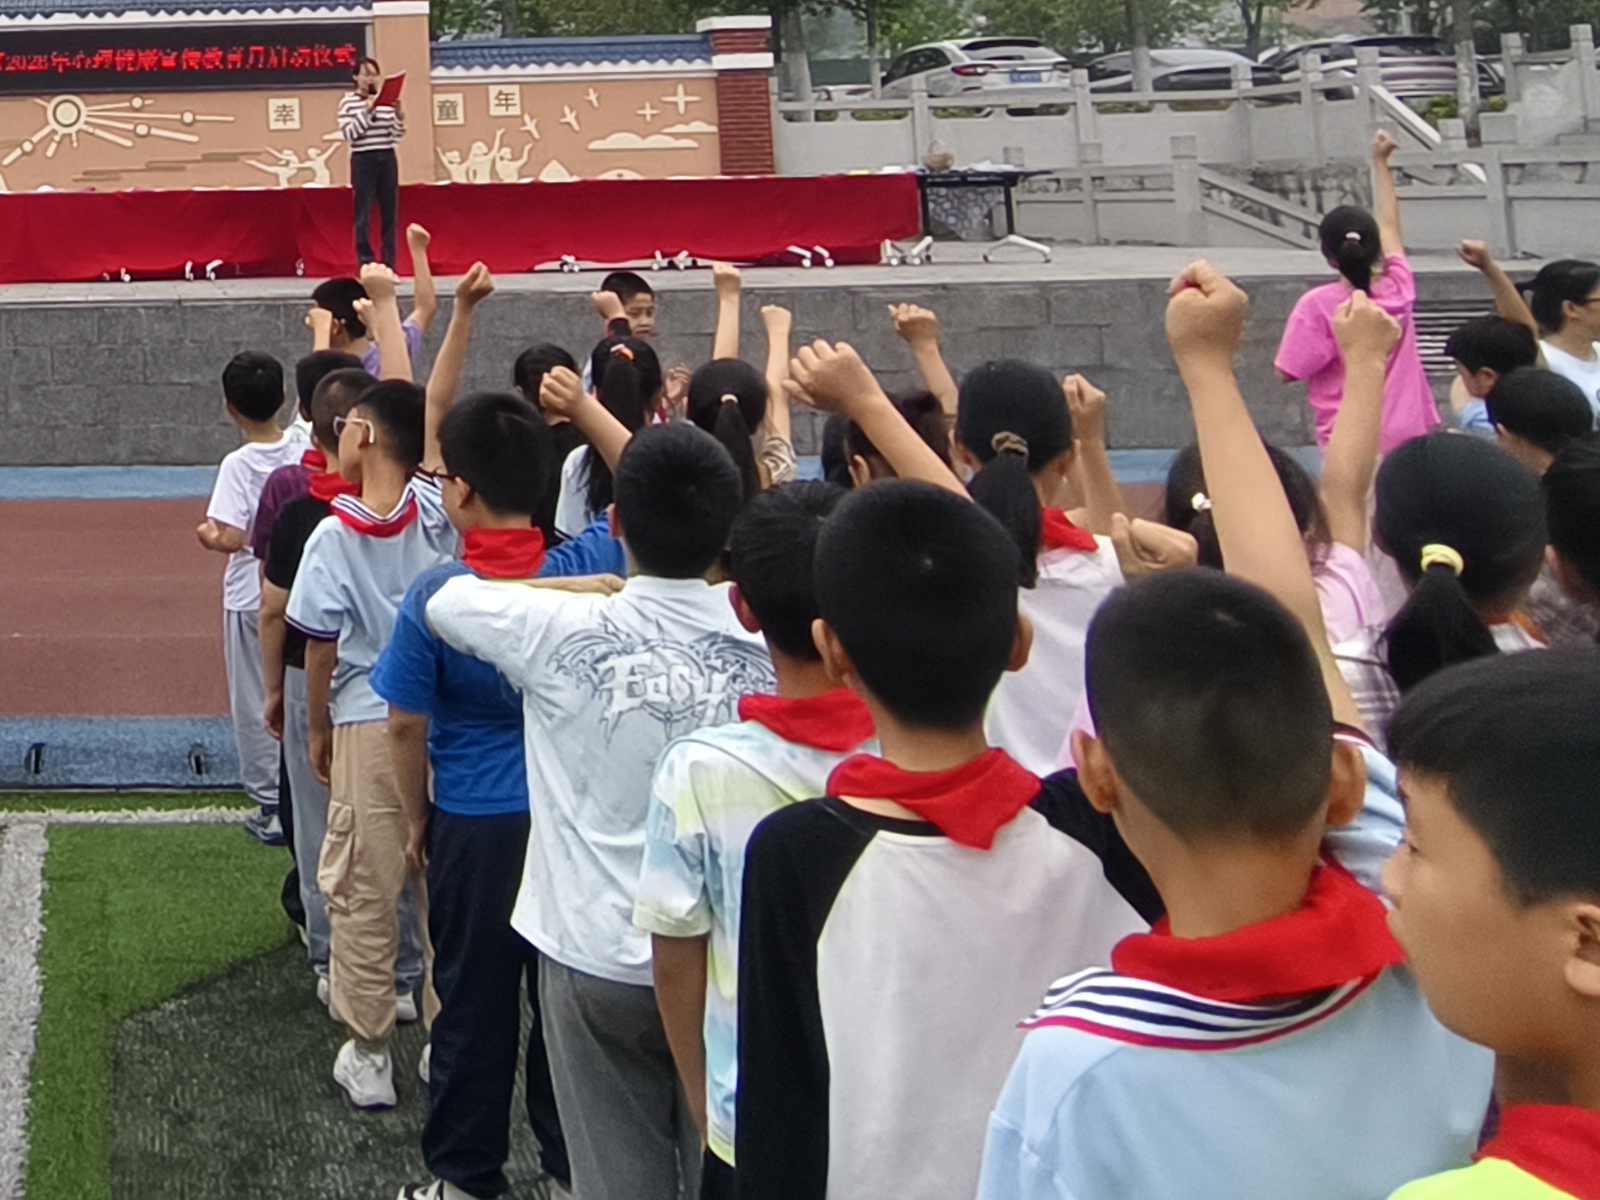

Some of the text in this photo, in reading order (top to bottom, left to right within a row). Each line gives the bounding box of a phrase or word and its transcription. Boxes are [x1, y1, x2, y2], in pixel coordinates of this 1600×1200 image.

[273, 89, 518, 126] 幸 童 年
